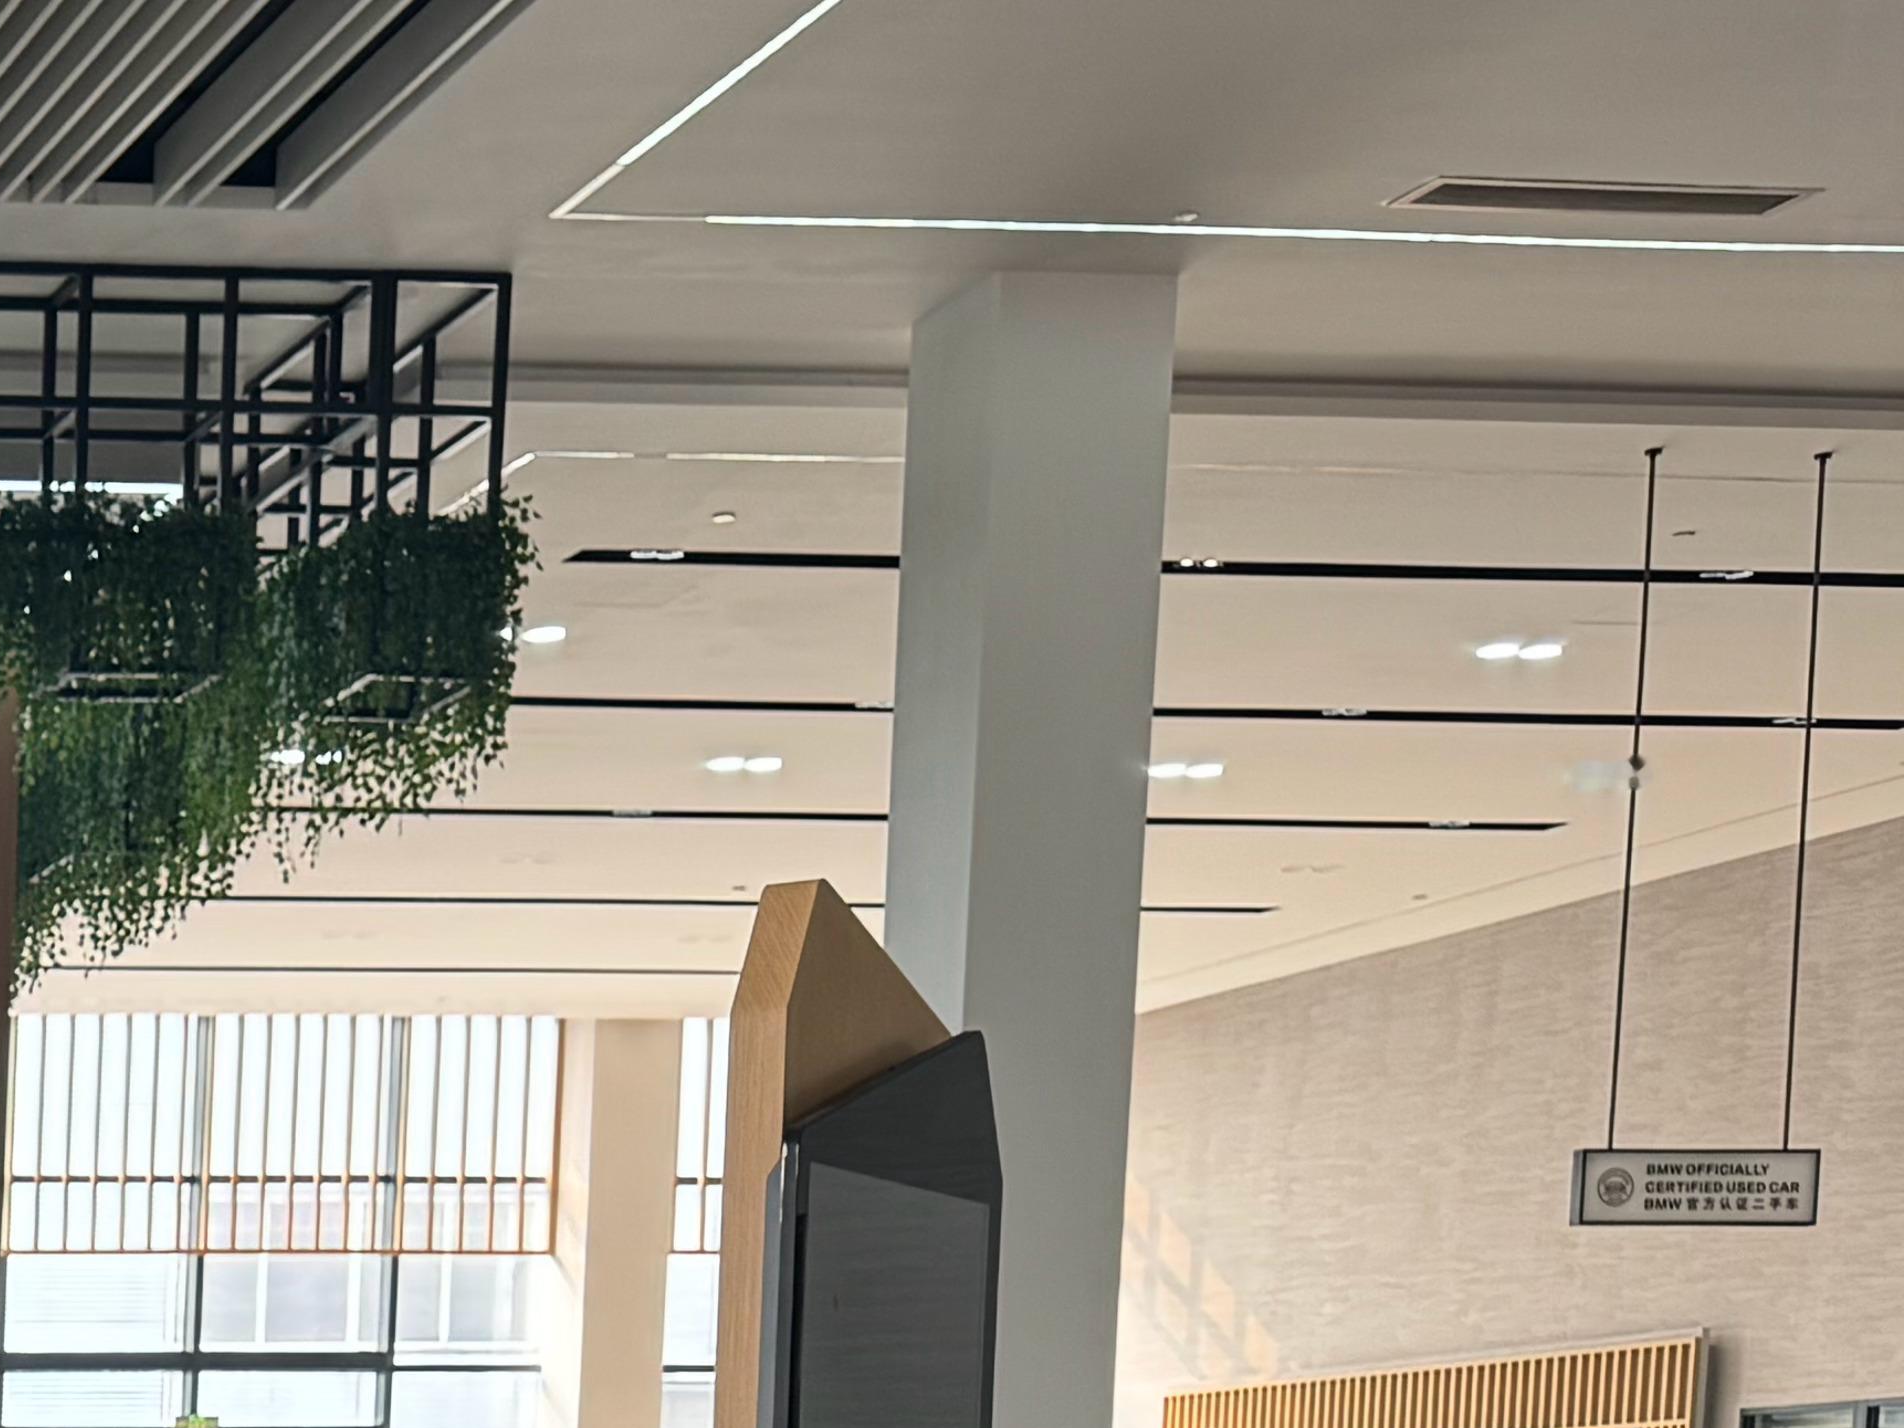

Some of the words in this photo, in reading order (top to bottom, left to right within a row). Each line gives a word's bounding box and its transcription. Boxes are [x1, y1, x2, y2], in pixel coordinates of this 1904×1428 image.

[1646, 1163, 1683, 1176] BMW
[1686, 1162, 1770, 1177] OFFICIALLY
[1645, 1180, 1723, 1194] CERTIFIED
[1726, 1180, 1765, 1194] USED
[1769, 1180, 1800, 1194] CAR
[1644, 1197, 1682, 1211] BMW
